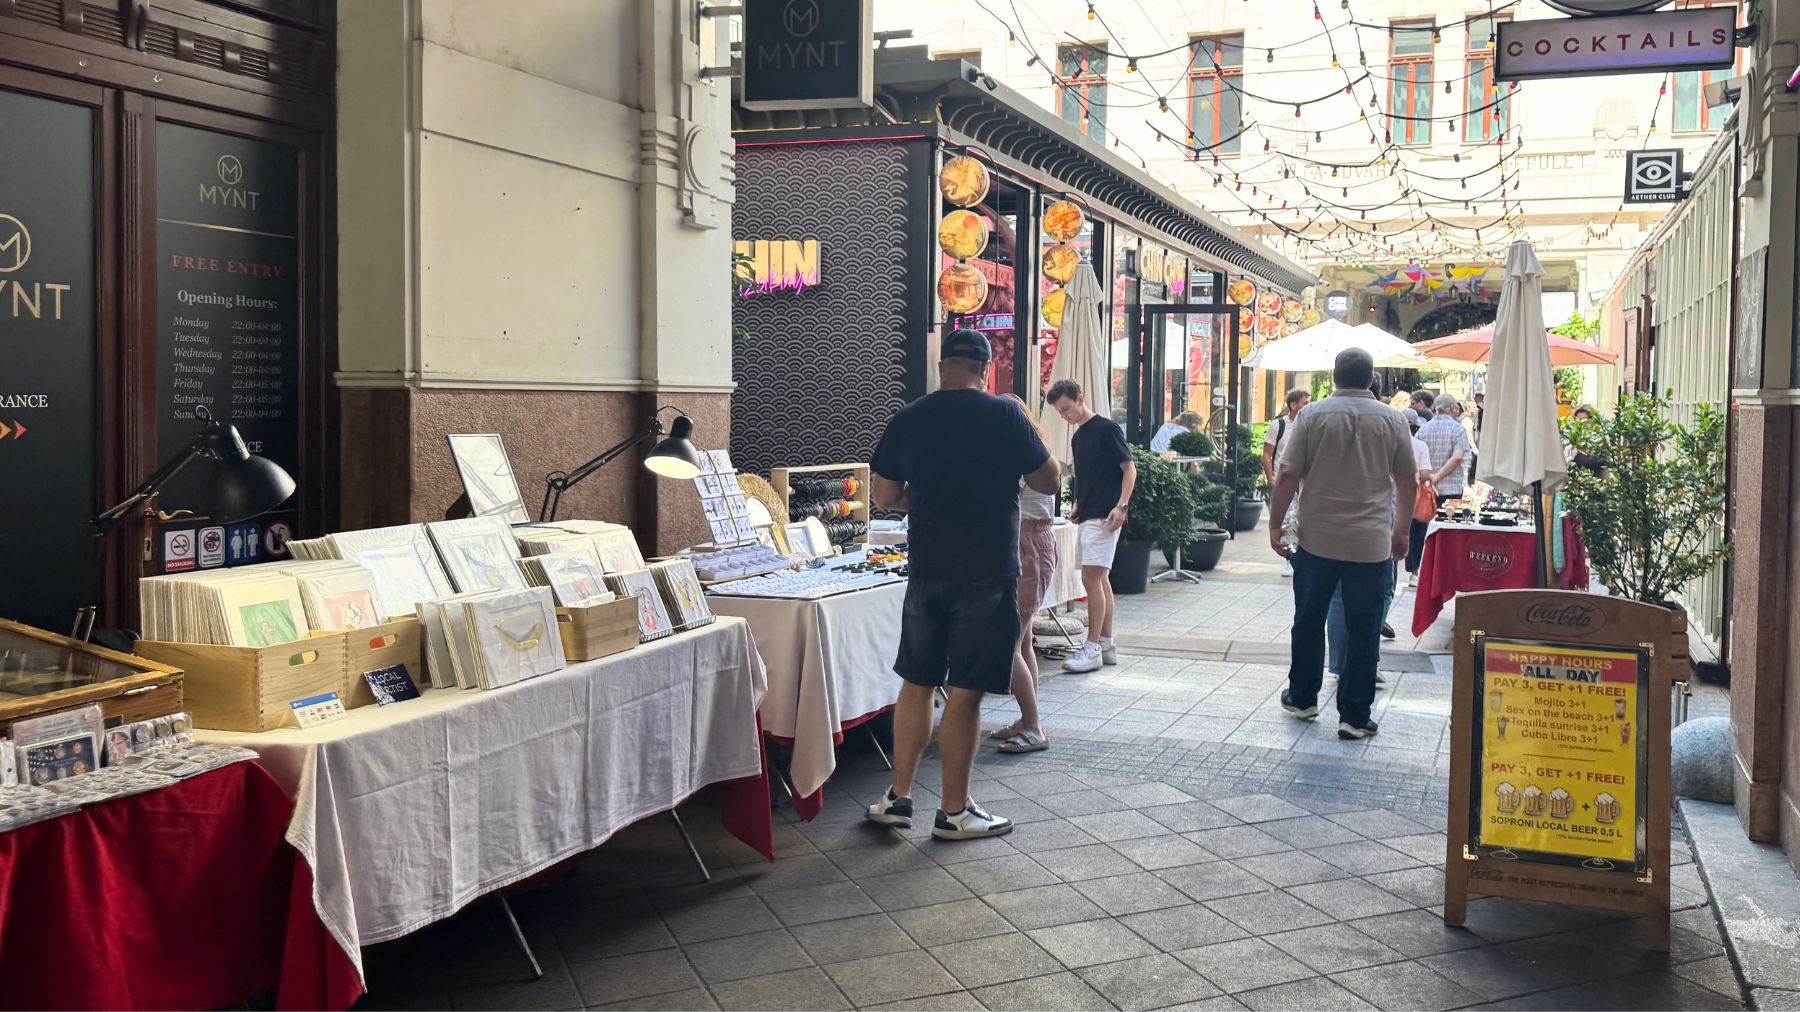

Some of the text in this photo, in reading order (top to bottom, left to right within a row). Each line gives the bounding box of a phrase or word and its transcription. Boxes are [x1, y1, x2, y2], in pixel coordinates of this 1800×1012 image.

[1506, 28, 1727, 57] COCKTAILS
[758, 40, 846, 70] MYNT
[200, 183, 260, 211] MYNT
[171, 254, 283, 278] FREE ENTRY
[177, 289, 278, 310] Opening Hours:
[173, 316, 210, 330] Monday
[173, 332, 210, 345] Tuesday
[173, 347, 223, 361] Wednesday
[173, 363, 216, 376] Thursday
[173, 378, 204, 390] Friday
[173, 394, 215, 406] Saturday
[1468, 551, 1509, 565] WEEKEND
[1508, 652, 1613, 671] HAPPY HOURS
[1524, 665, 1601, 683] ALL DAY
[1493, 677, 1627, 697] PAY 3, GET +1 FREE!
[1534, 696, 1586, 709] Mojito 3+1
[1506, 705, 1525, 715] Sex
[1543, 709, 1560, 719] the
[1562, 711, 1594, 722] beach
[1596, 713, 1615, 723] 3+1
[1550, 720, 1589, 732] sunrise
[1591, 724, 1610, 734] 3+1
[1521, 730, 1549, 740] Cuba
[1579, 734, 1599, 744] 3+1
[1491, 762, 1626, 785] PAY 3, GET +1 FREE!
[1490, 815, 1624, 838] SOPRONI LOCAL BEER 0,5 L
